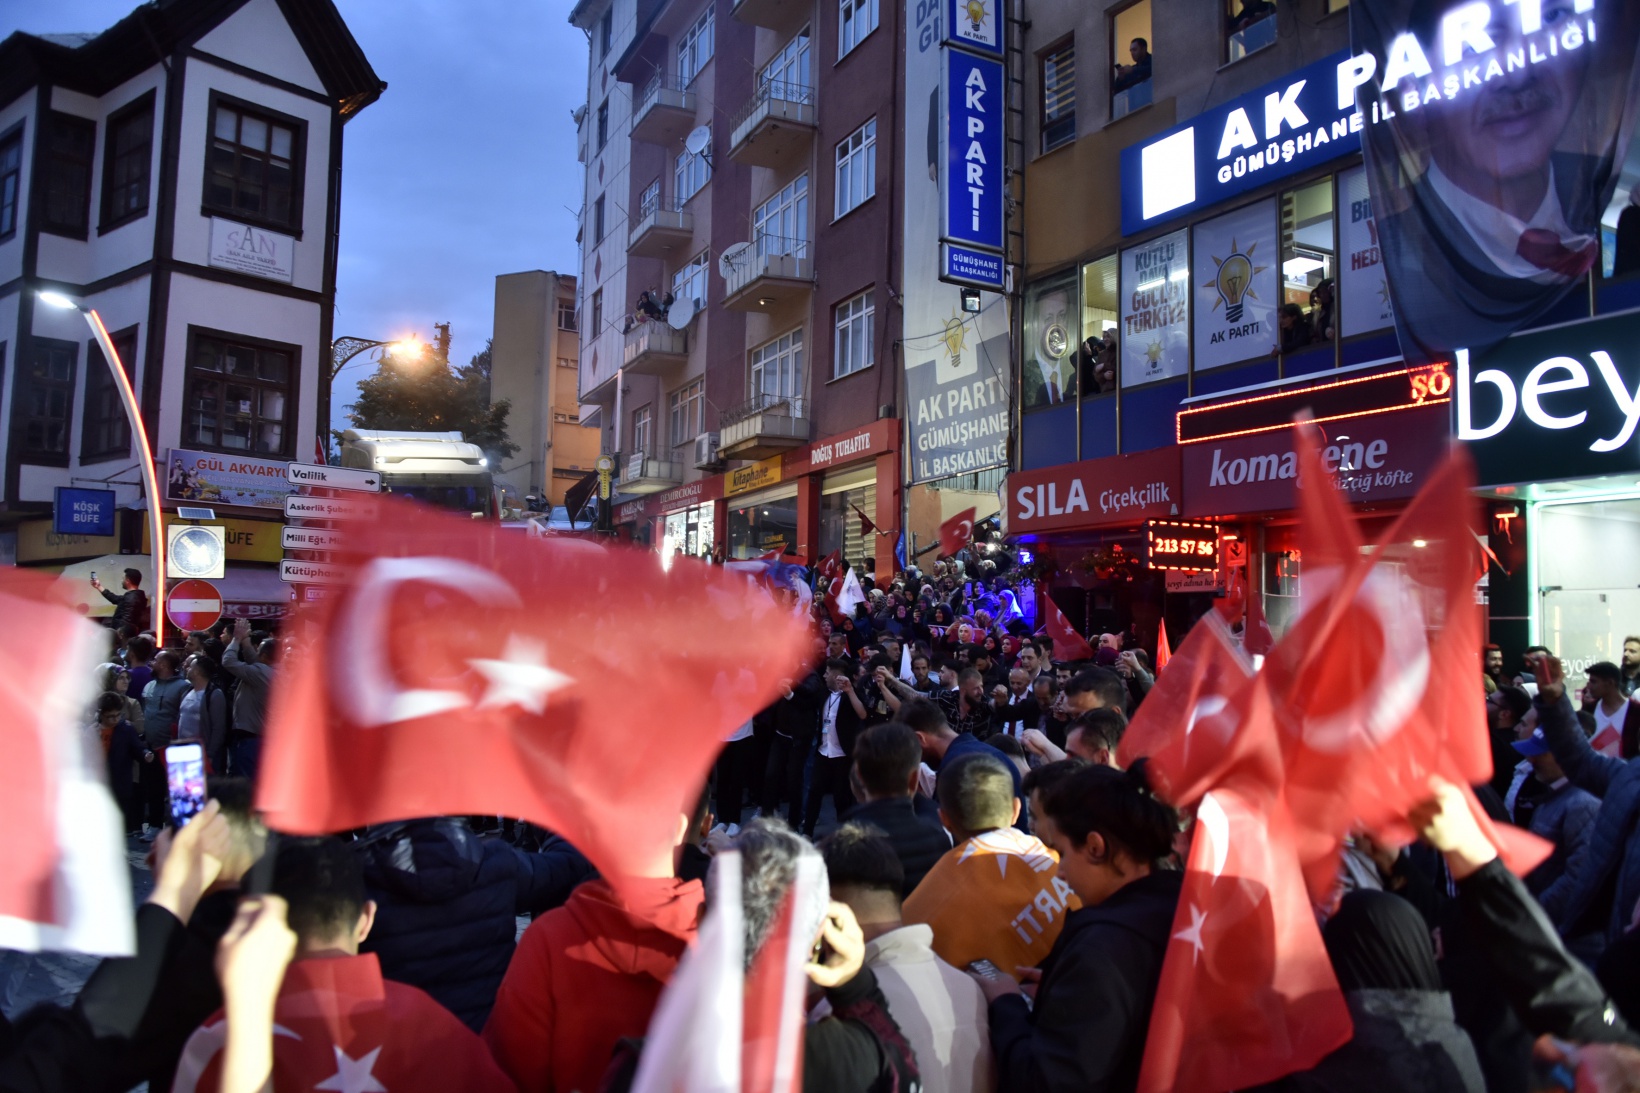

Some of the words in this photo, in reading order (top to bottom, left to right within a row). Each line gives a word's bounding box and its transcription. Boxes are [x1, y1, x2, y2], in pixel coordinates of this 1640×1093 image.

[1217, 112, 1364, 184] GÜMÜŞHANE
[1372, 102, 1395, 125] İL
[1403, 19, 1597, 112] BAŞKANLIĞI
[1217, 79, 1310, 161] AK
[226, 226, 277, 257] SAN
[952, 254, 998, 270] GÜMÜŞHANE
[953, 263, 960, 271] İL
[960, 265, 998, 279] BAŞKANLIĞI
[1210, 330, 1225, 345] AK
[917, 393, 944, 426] AK
[947, 367, 1006, 417] PARTİ
[1455, 348, 1640, 453] bey
[917, 410, 1010, 452] GÜMÜŞHANE
[811, 443, 833, 465] DOĞUŞ
[835, 431, 871, 458] TUHAFİYE
[196, 457, 225, 472] GÜL
[919, 457, 932, 478] İL
[1209, 438, 1388, 487] komaene
[292, 469, 327, 481] Valilik
[733, 465, 769, 488] kitaphane
[1350, 473, 1373, 493] çiğ
[1375, 469, 1413, 488] köfte
[73, 501, 100, 513] KÖŞK
[289, 503, 325, 512] Askerlik
[1016, 478, 1090, 520] SILA
[1100, 482, 1170, 514] Çiçekçilik
[73, 513, 100, 523] BÜFE
[225, 528, 254, 546] ÜFE
[286, 533, 306, 542] Milli
[308, 535, 326, 546] Eğt.
[1155, 538, 1178, 554] 213
[1180, 539, 1195, 555] 57
[1197, 541, 1214, 556] 56
[1167, 579, 1183, 590] sevgi
